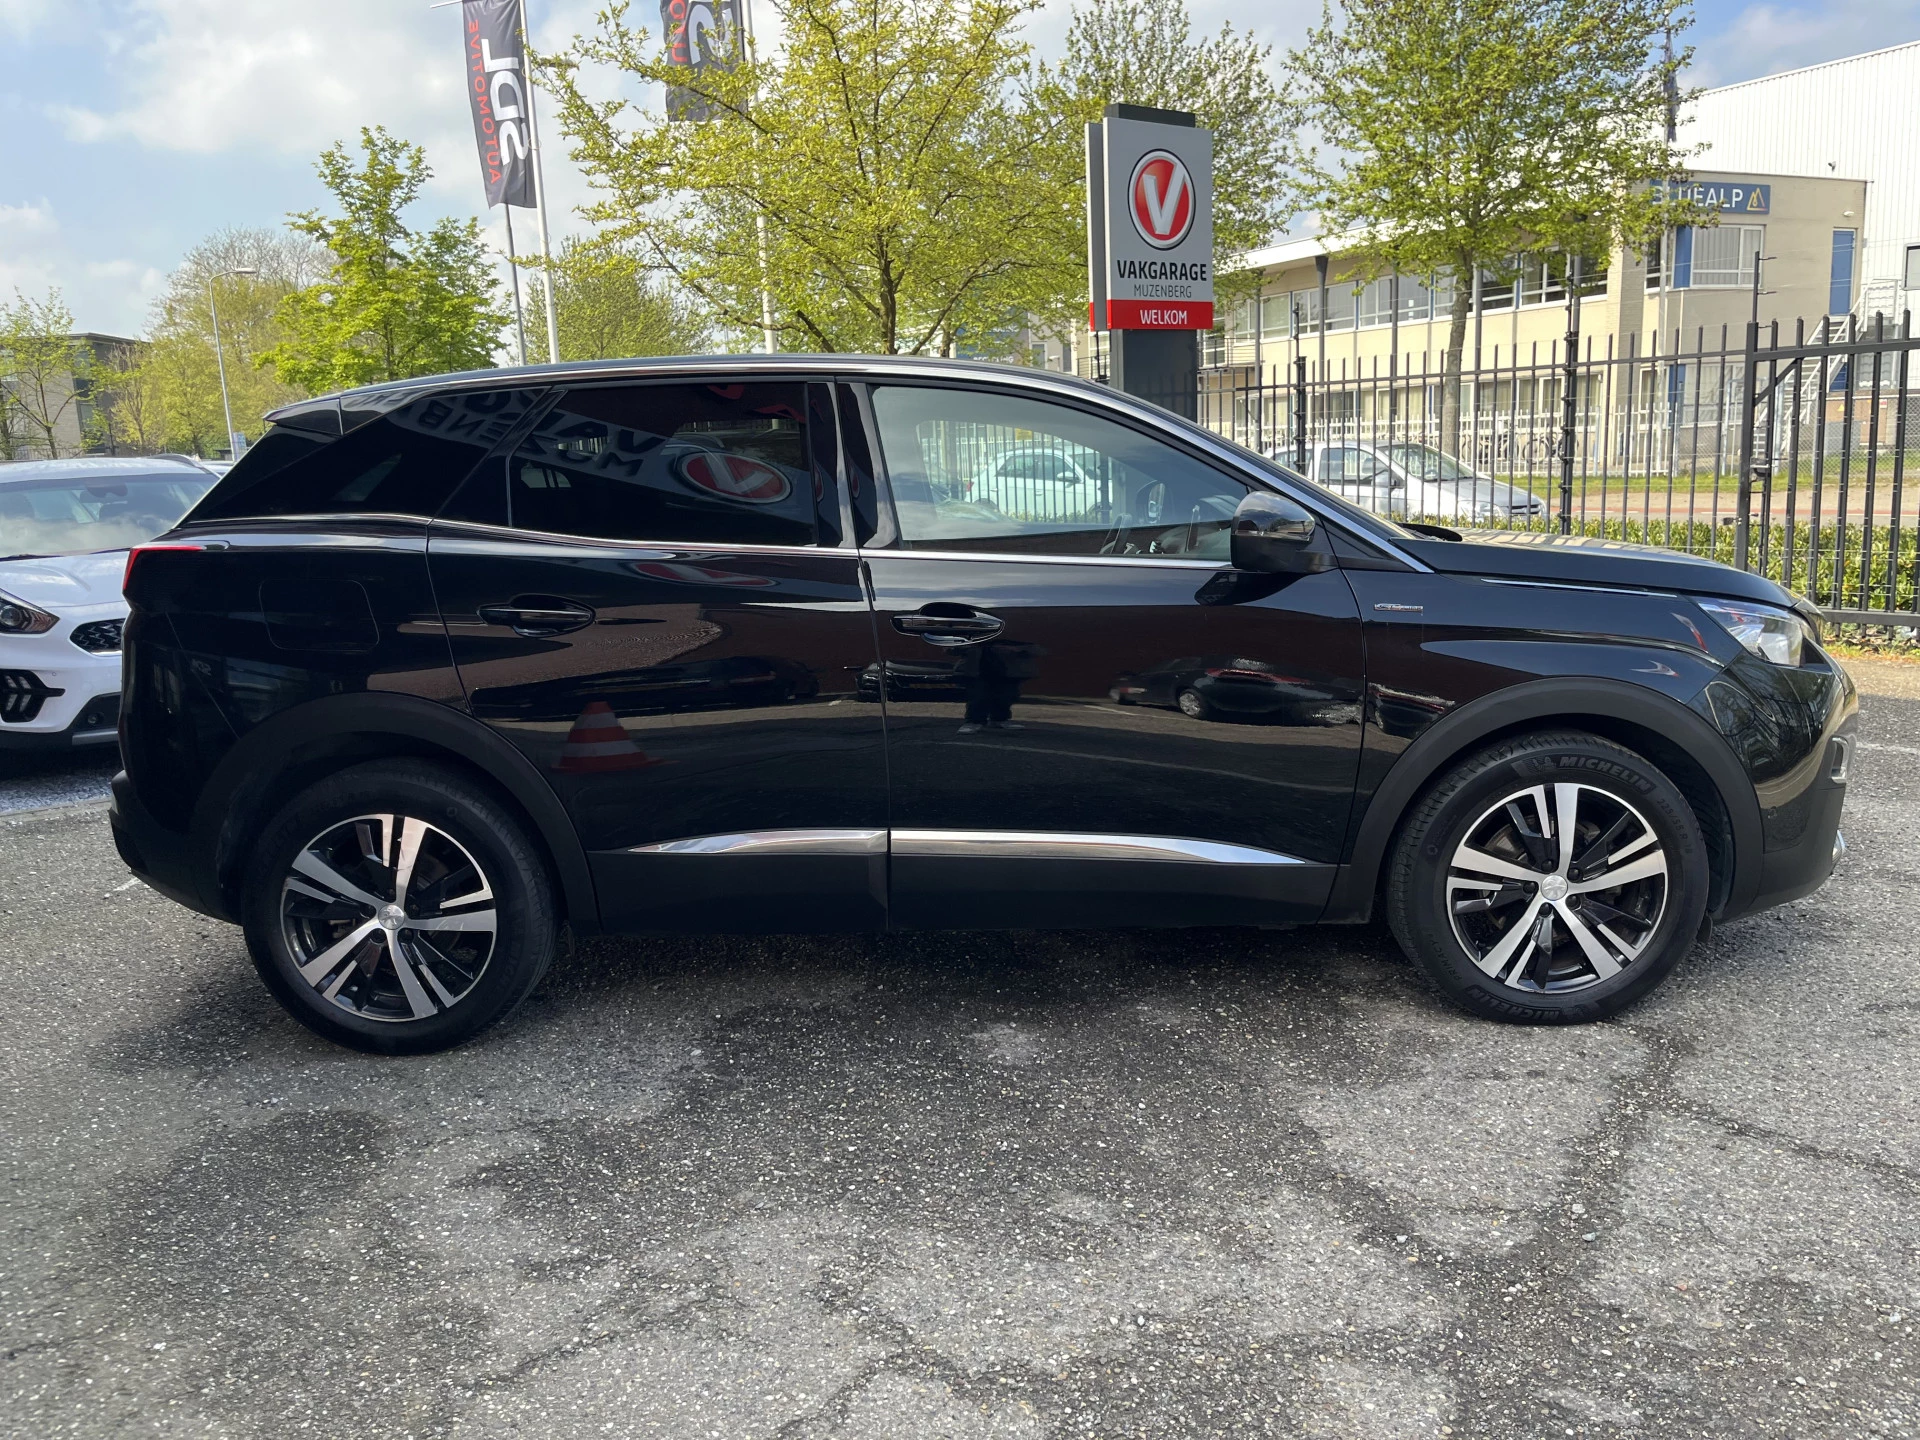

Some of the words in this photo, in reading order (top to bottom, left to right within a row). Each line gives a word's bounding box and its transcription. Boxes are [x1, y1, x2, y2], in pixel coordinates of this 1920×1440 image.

[1116, 259, 1207, 282] VAKGARAGE
[1133, 284, 1192, 298] MUZENBERG
[1140, 309, 1188, 325] WELKOM
[1558, 755, 1655, 794] MICHELIN
[1466, 987, 1560, 1021] MICHELIN
